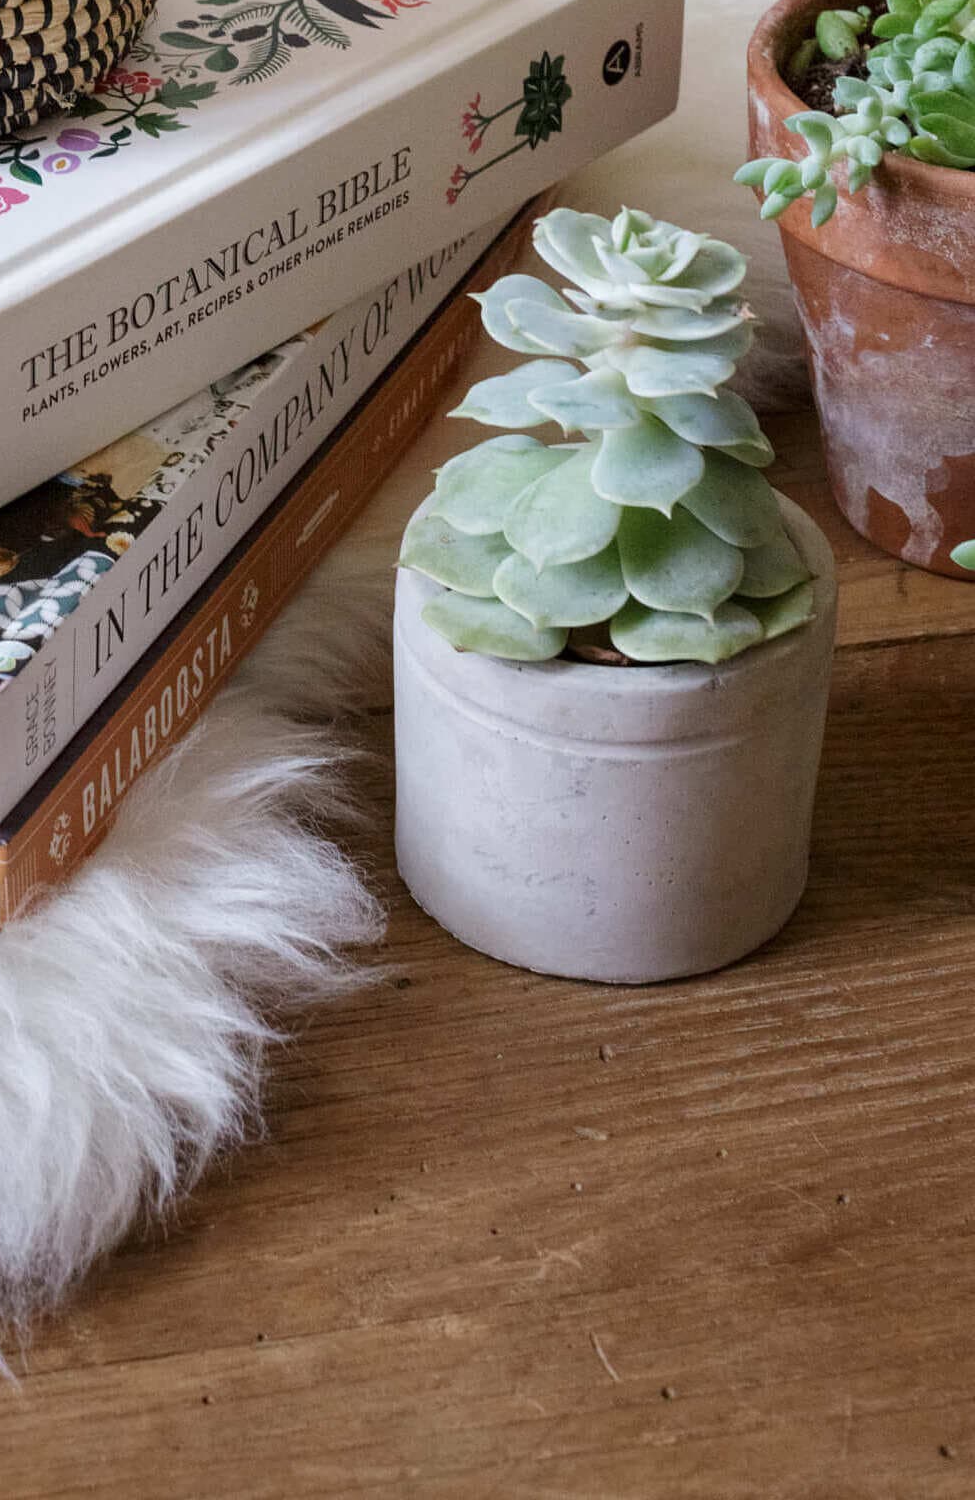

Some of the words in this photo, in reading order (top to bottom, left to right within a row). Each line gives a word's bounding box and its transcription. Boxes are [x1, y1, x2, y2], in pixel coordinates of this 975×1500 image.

[21, 323, 98, 392] THE
[107, 208, 308, 347] BOTANICAL
[314, 146, 412, 229] BIBLE
[22, 382, 79, 422] PLANTS,
[83, 340, 152, 388] FLOWERS,
[154, 320, 184, 347] ART,
[188, 286, 242, 328] RECIPES
[245, 279, 255, 294] &
[258, 252, 302, 286] OTHER
[305, 228, 344, 260] HOME
[347, 190, 410, 237] REMEDIES
[93, 588, 128, 677] IN
[138, 502, 204, 618] THE
[214, 325, 358, 528] COMPANY
[362, 275, 401, 357] OF
[82, 615, 232, 836] BALABOOSTA
